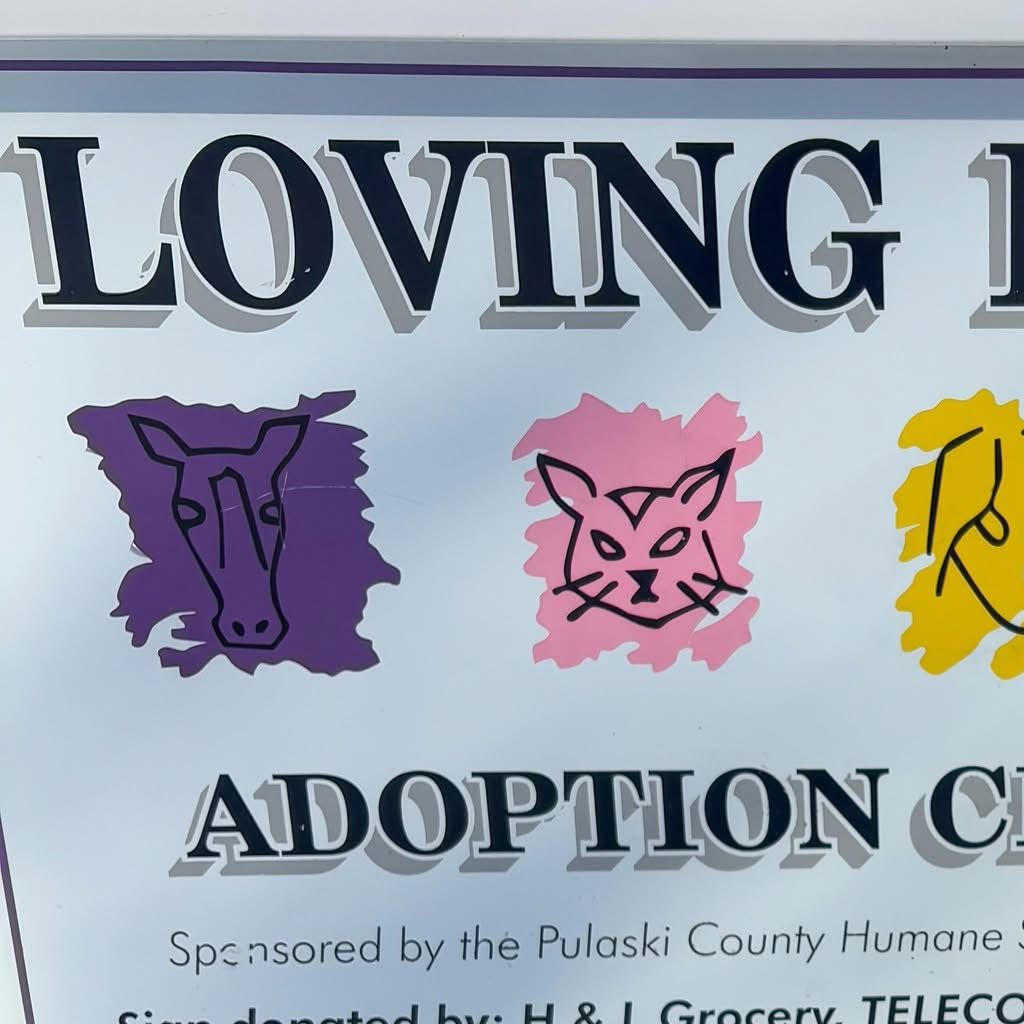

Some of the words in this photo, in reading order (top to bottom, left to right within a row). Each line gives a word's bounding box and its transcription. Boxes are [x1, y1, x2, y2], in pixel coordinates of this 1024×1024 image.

[18, 134, 901, 311] LOVING
[187, 767, 889, 858] ADOPTION
[400, 926, 445, 972] by
[459, 924, 521, 961] the
[538, 921, 671, 960] Pulaski
[687, 921, 826, 965] County
[841, 919, 1003, 954] Humane
